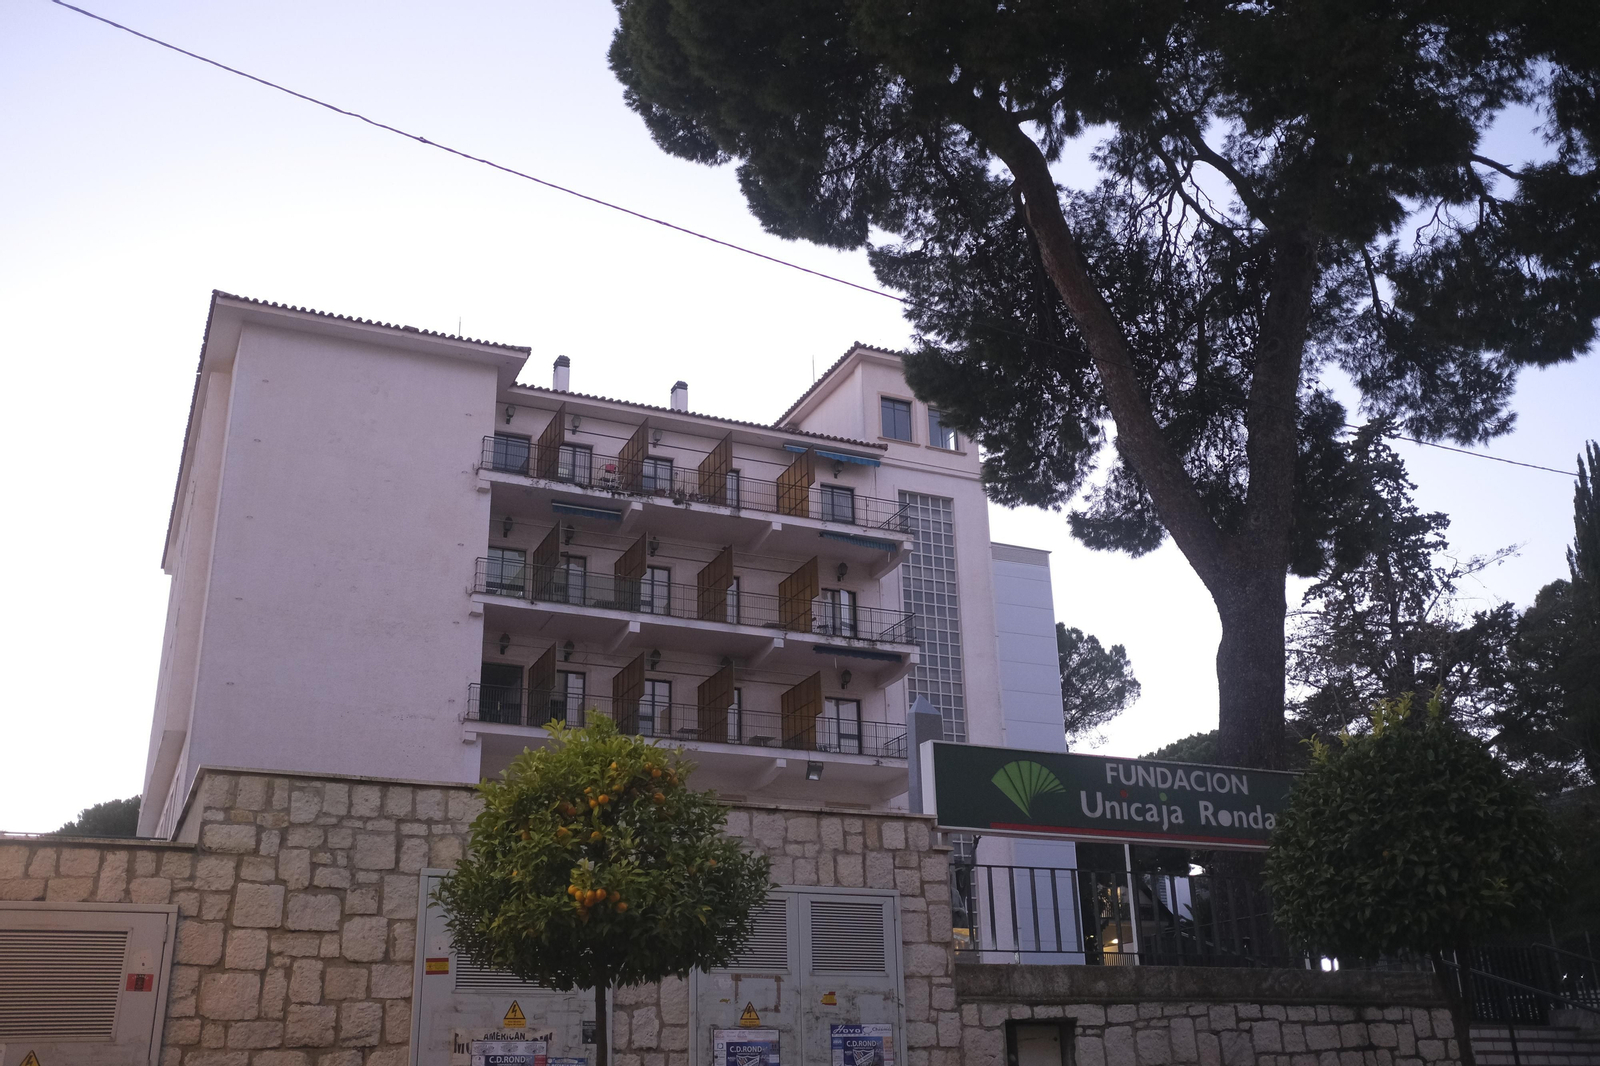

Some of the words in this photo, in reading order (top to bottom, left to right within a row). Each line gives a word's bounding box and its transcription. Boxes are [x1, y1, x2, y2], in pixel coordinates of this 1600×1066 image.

[1106, 763, 1249, 795] FUNDACION
[1080, 789, 1184, 831] Unicaja
[1198, 800, 1276, 830] Ronda
